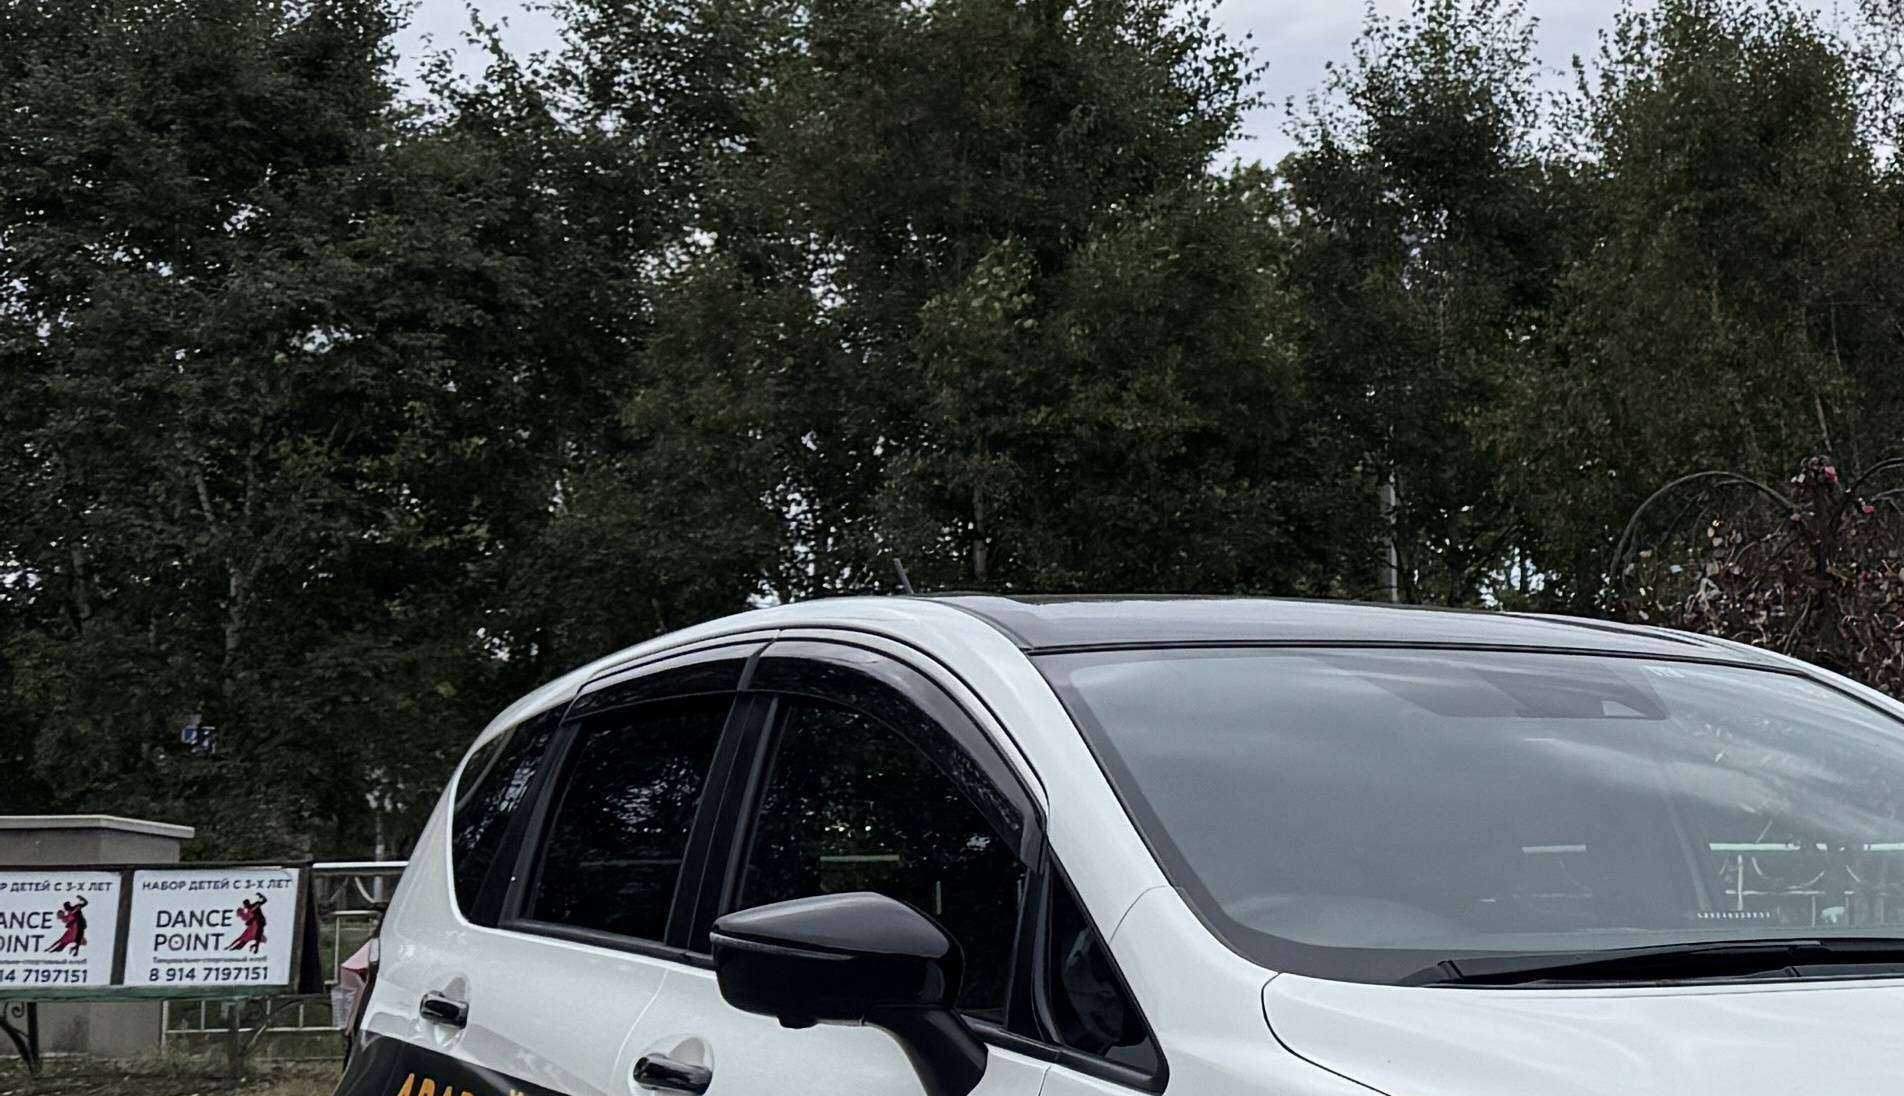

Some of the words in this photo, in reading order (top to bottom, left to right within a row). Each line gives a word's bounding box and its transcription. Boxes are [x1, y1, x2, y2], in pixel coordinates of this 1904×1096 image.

[54, 882, 62, 891] С
[88, 882, 113, 891] ЛЕТ
[188, 878, 229, 891] ДЕТЕЙ
[233, 881, 241, 889] С
[267, 879, 292, 889] ЛЕТ
[156, 909, 234, 928] DANCE
[153, 933, 225, 951] POINT
[23, 969, 88, 983] 7197151
[149, 967, 159, 981] 8
[165, 967, 196, 982] 914
[203, 966, 268, 981] 7197151
